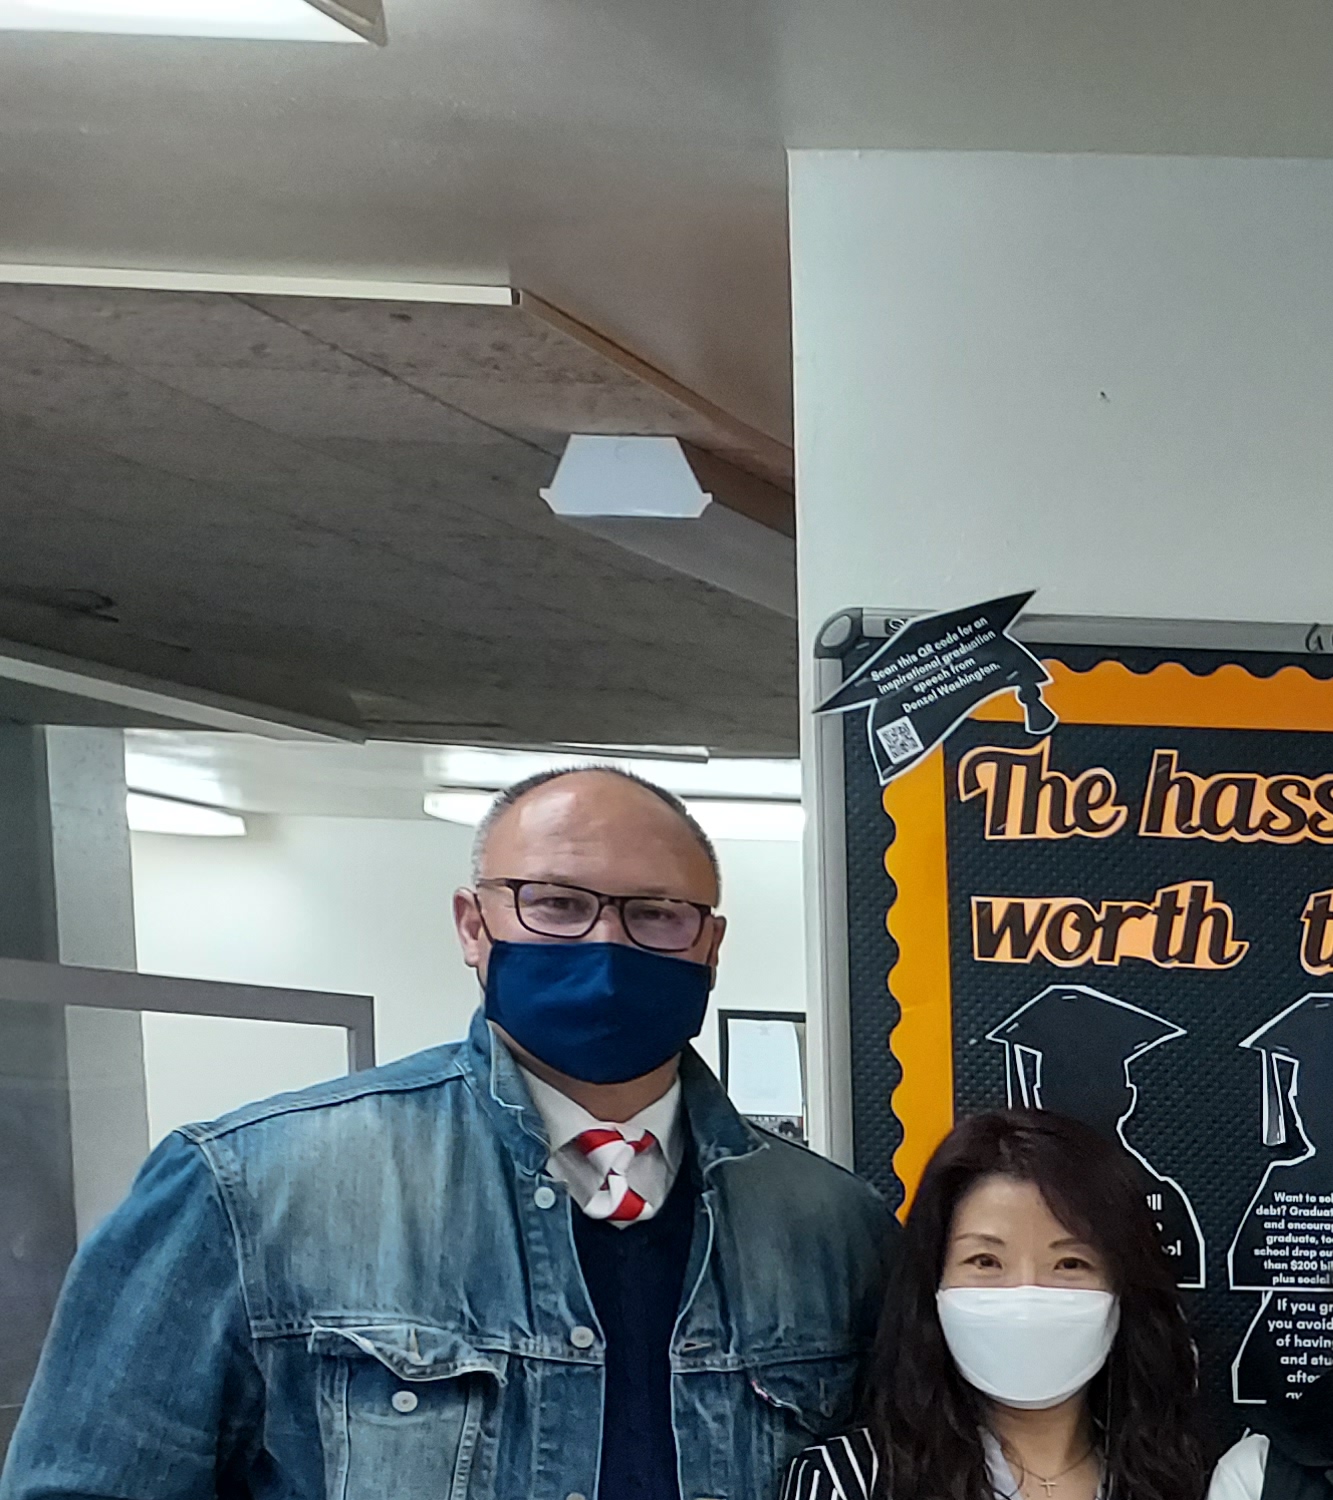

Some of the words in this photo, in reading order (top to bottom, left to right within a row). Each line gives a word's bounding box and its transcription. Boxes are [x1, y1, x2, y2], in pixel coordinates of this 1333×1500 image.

[870, 663, 898, 682] Scan
[897, 654, 918, 668] this
[917, 644, 936, 658] QR
[934, 632, 960, 650] code
[957, 625, 973, 637] for
[974, 617, 988, 629] an
[877, 655, 942, 695] inspirational
[942, 630, 996, 665] graduation
[912, 668, 952, 693] speech
[950, 657, 976, 674] from
[902, 689, 938, 713] Denzel
[936, 662, 1002, 697] Washington.
[958, 736, 1128, 841] The
[971, 880, 1250, 969] worth
[1274, 1191, 1304, 1203] Want
[1305, 1193, 1316, 1203] to
[1256, 1204, 1287, 1216] debt?
[1264, 1218, 1285, 1230] and
[1266, 1232, 1319, 1245] graduate,
[1254, 1246, 1290, 1256] school
[1292, 1246, 1317, 1260] drop
[1264, 1258, 1288, 1270] than
[1290, 1260, 1318, 1272] $200
[1272, 1272, 1296, 1286] plus
[1297, 1273, 1330, 1284] social
[1277, 1298, 1288, 1312] If
[1290, 1302, 1316, 1316] you
[1268, 1320, 1293, 1332] you
[1276, 1334, 1292, 1347] of
[1280, 1352, 1308, 1365] and
